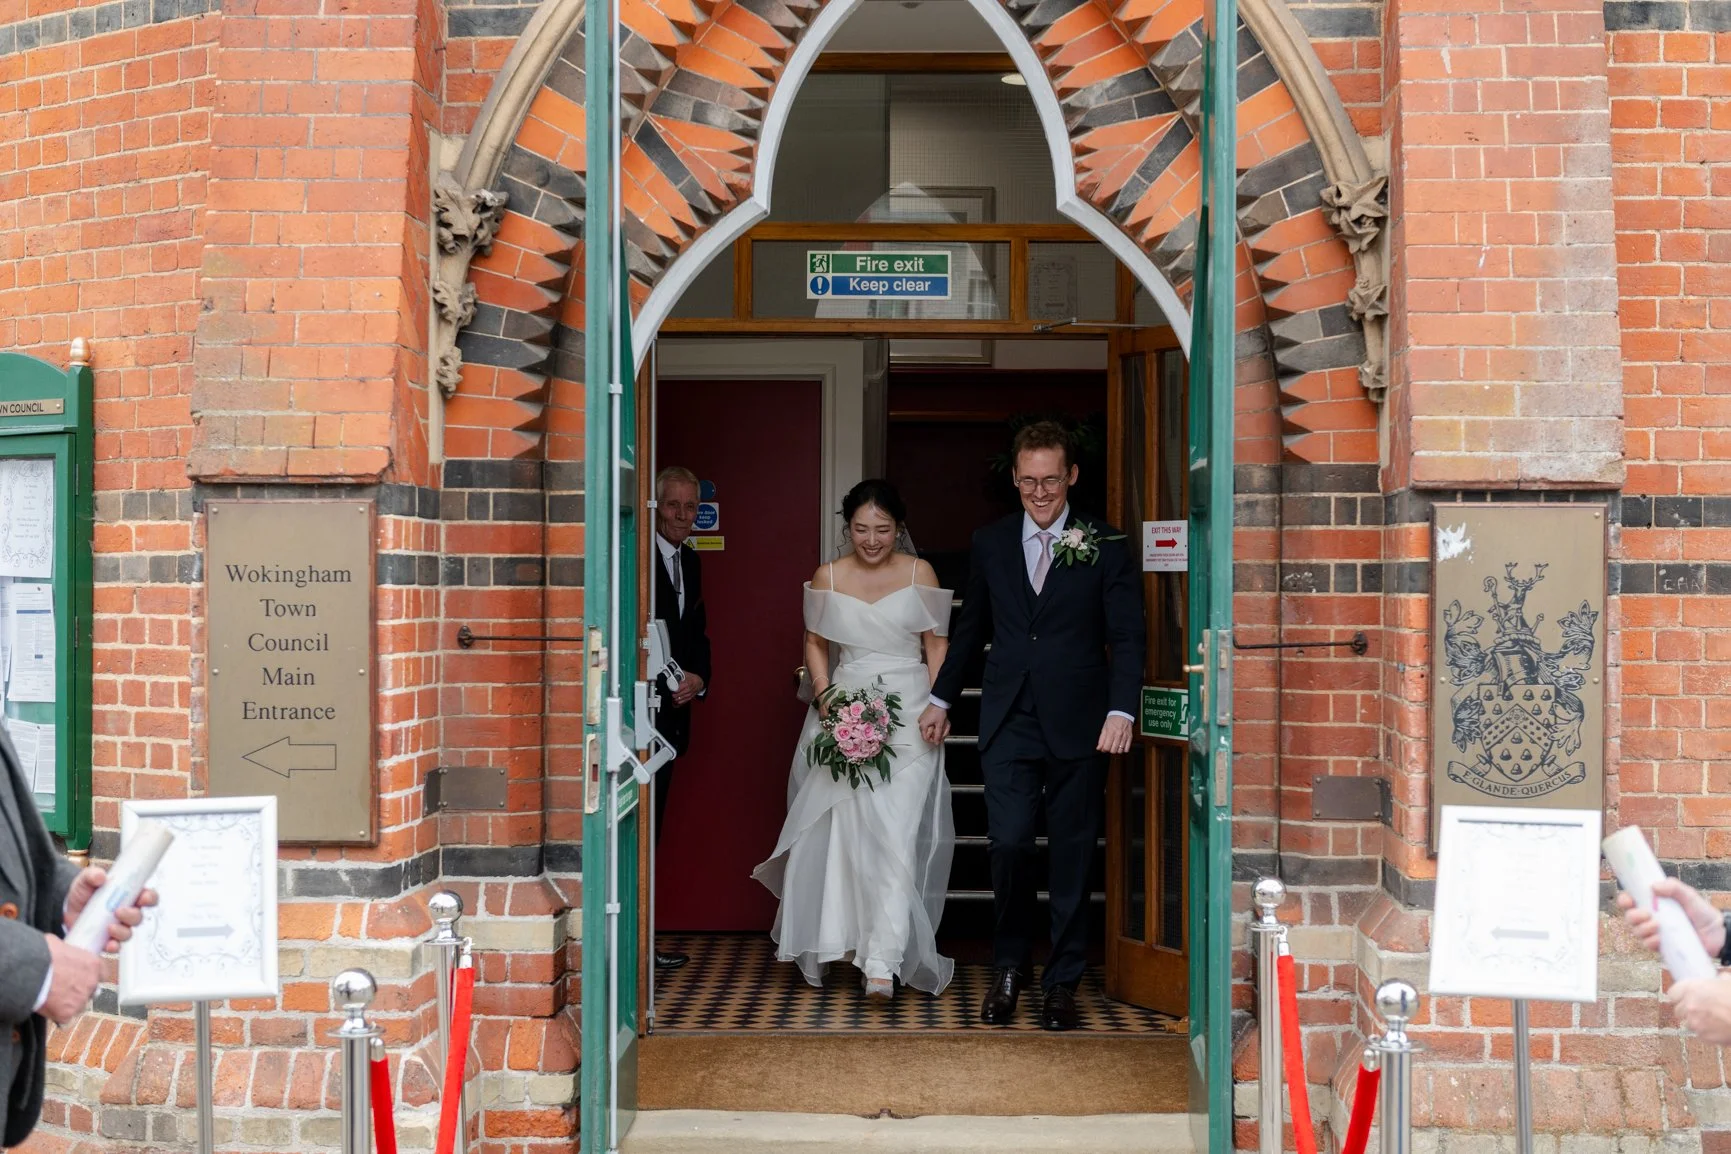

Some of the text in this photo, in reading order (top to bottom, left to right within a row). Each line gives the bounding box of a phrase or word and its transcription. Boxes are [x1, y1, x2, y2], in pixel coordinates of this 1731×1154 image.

[856, 256, 924, 272] Fire exit
[850, 278, 931, 294] Keep clear
[10, 402, 44, 413] COUNCIL
[225, 564, 351, 588] Wokingham
[259, 598, 316, 617] Town
[248, 633, 329, 652] Council
[262, 667, 315, 686] Main
[1144, 695, 1176, 707] Fire exit for
[242, 701, 336, 720] Entrance
[1144, 708, 1176, 720] emergency
[1159, 720, 1172, 731] only
